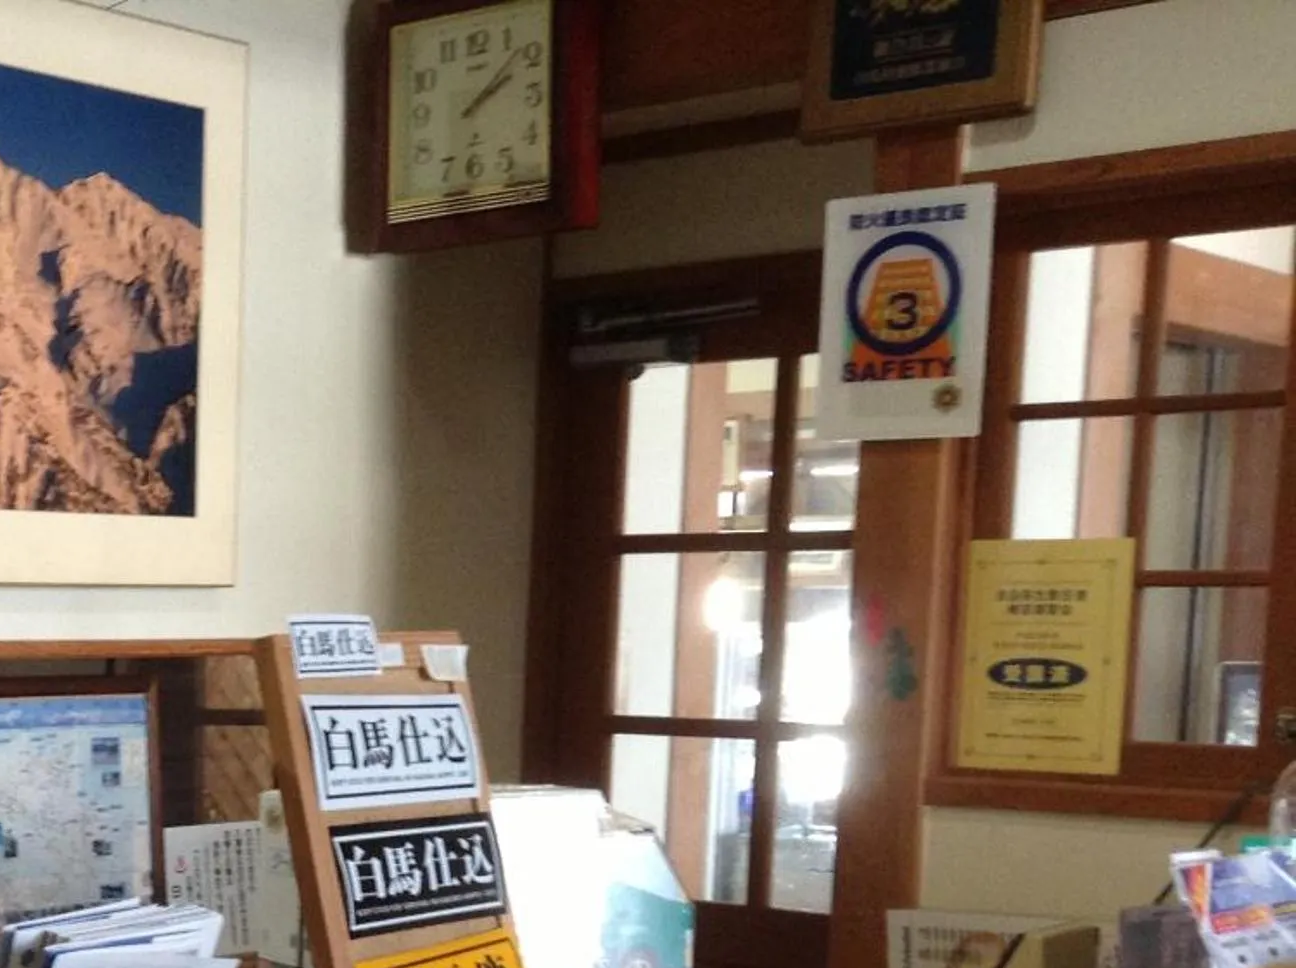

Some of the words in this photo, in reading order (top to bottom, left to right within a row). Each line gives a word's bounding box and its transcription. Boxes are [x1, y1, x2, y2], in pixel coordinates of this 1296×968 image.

[885, 291, 919, 330] 3
[843, 356, 956, 382] SAFETY
[296, 627, 375, 657] 白馬仕込
[322, 713, 467, 771] 白馬仕込
[345, 833, 494, 902] 白馬仕込
